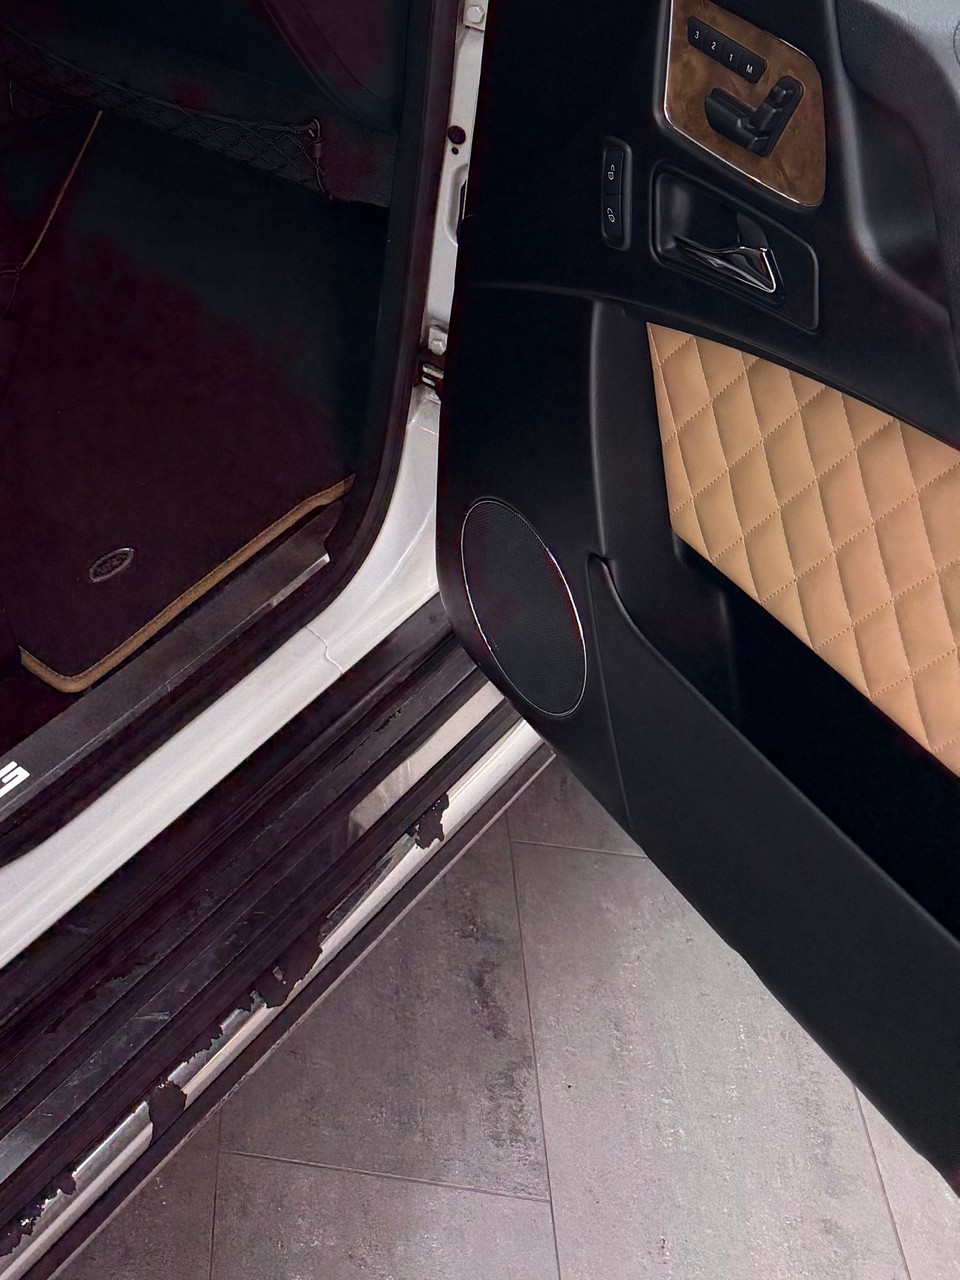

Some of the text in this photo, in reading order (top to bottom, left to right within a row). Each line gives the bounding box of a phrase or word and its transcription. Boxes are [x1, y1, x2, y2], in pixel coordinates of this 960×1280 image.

[694, 30, 753, 74] 3 2 1 M
